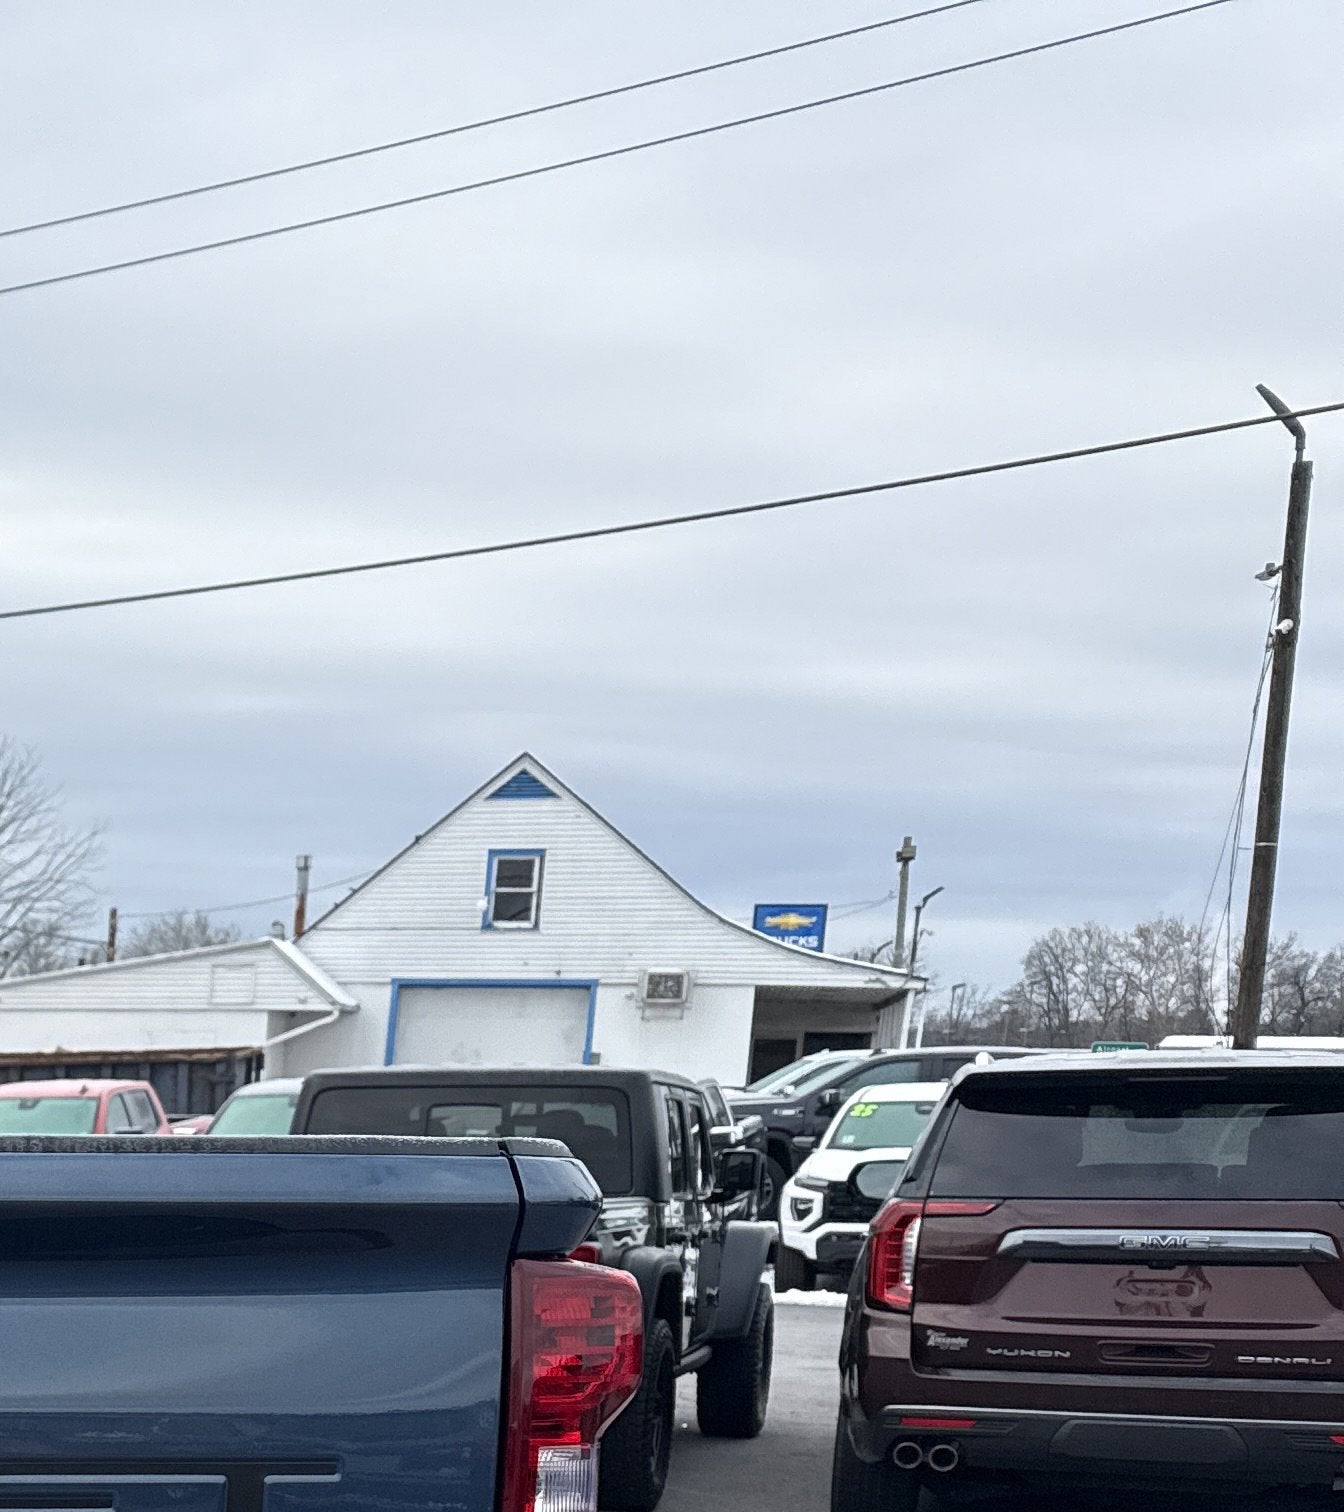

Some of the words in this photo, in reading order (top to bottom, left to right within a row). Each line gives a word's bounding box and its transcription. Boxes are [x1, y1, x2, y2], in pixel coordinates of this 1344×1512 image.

[771, 935, 819, 948] UCKS
[1118, 1235, 1210, 1250] GMC
[986, 1347, 1071, 1358] YUKON
[1237, 1355, 1332, 1365] DENALI
